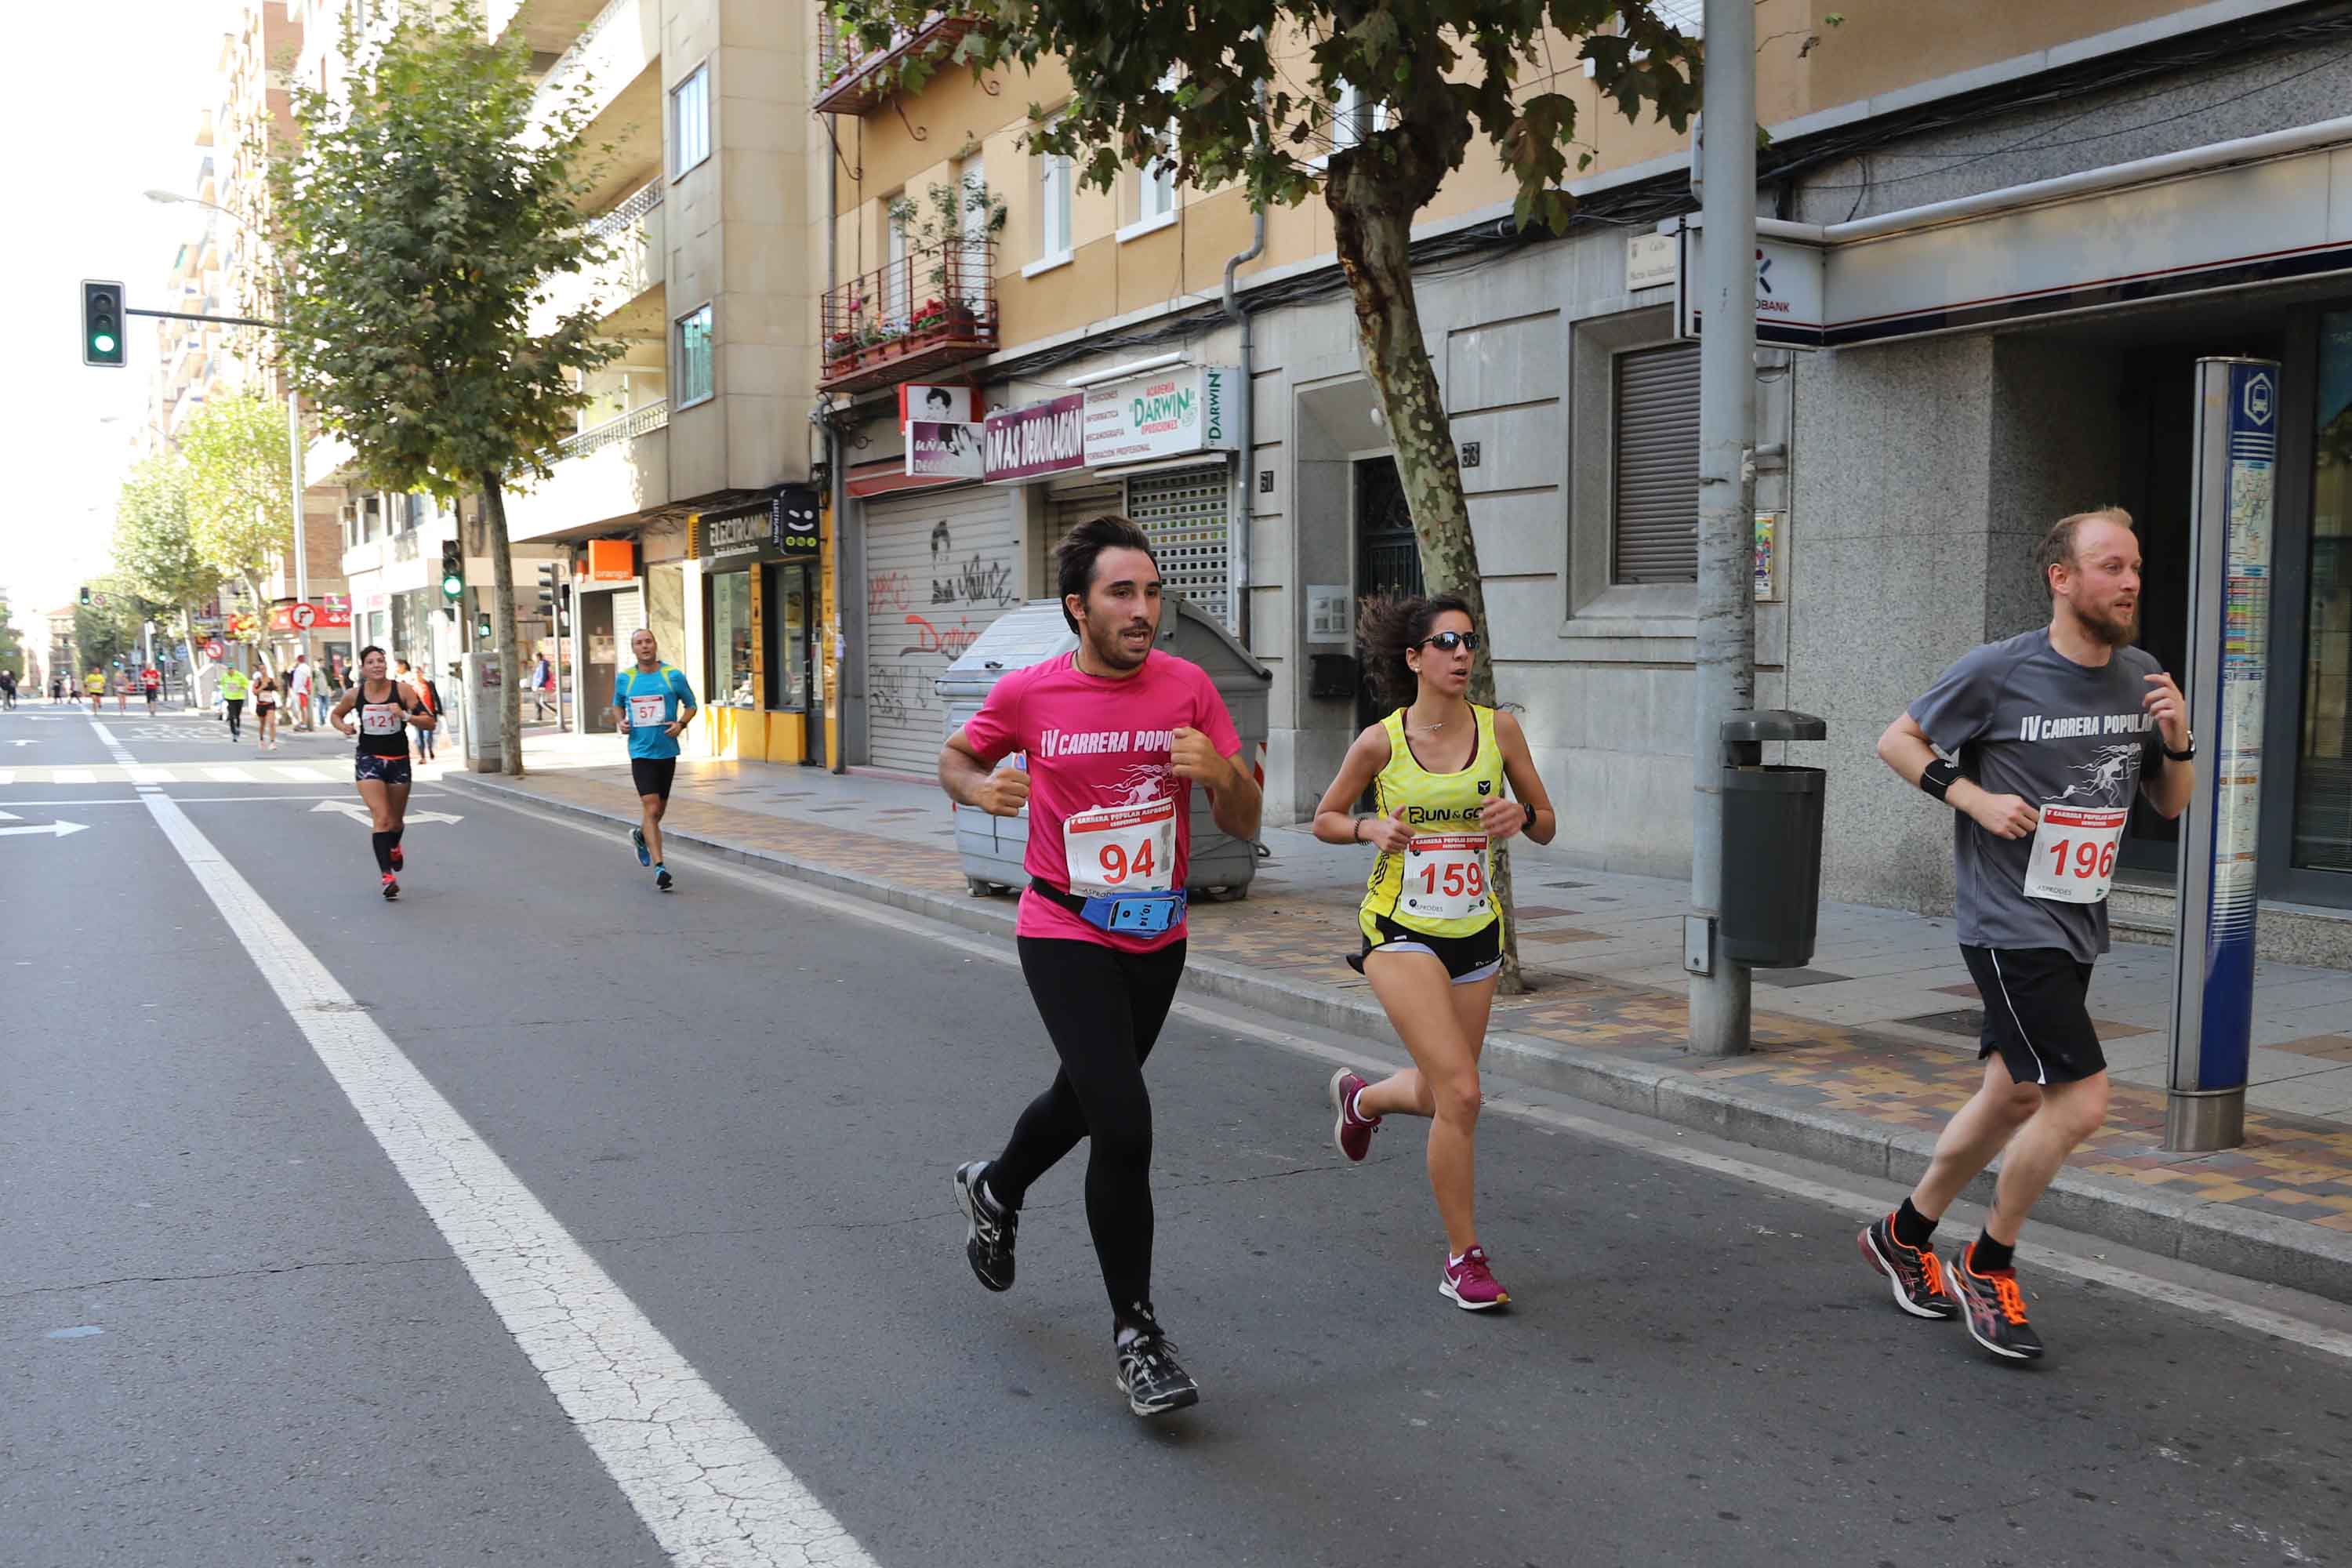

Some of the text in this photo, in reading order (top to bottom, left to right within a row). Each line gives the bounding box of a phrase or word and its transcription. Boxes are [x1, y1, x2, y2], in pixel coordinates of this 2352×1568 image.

[369, 713, 395, 728] 121
[639, 706, 656, 719] 57
[2020, 715, 2041, 742] IV
[2041, 717, 2099, 740] CARRERA
[1041, 729, 1059, 757] IV
[1058, 730, 1127, 756] CARRERA
[1077, 815, 1109, 825] CARRERA
[1110, 811, 1141, 821] POPULAR
[1099, 838, 1155, 885] 94
[2049, 839, 2116, 879] 196
[1420, 862, 1484, 897] 159
